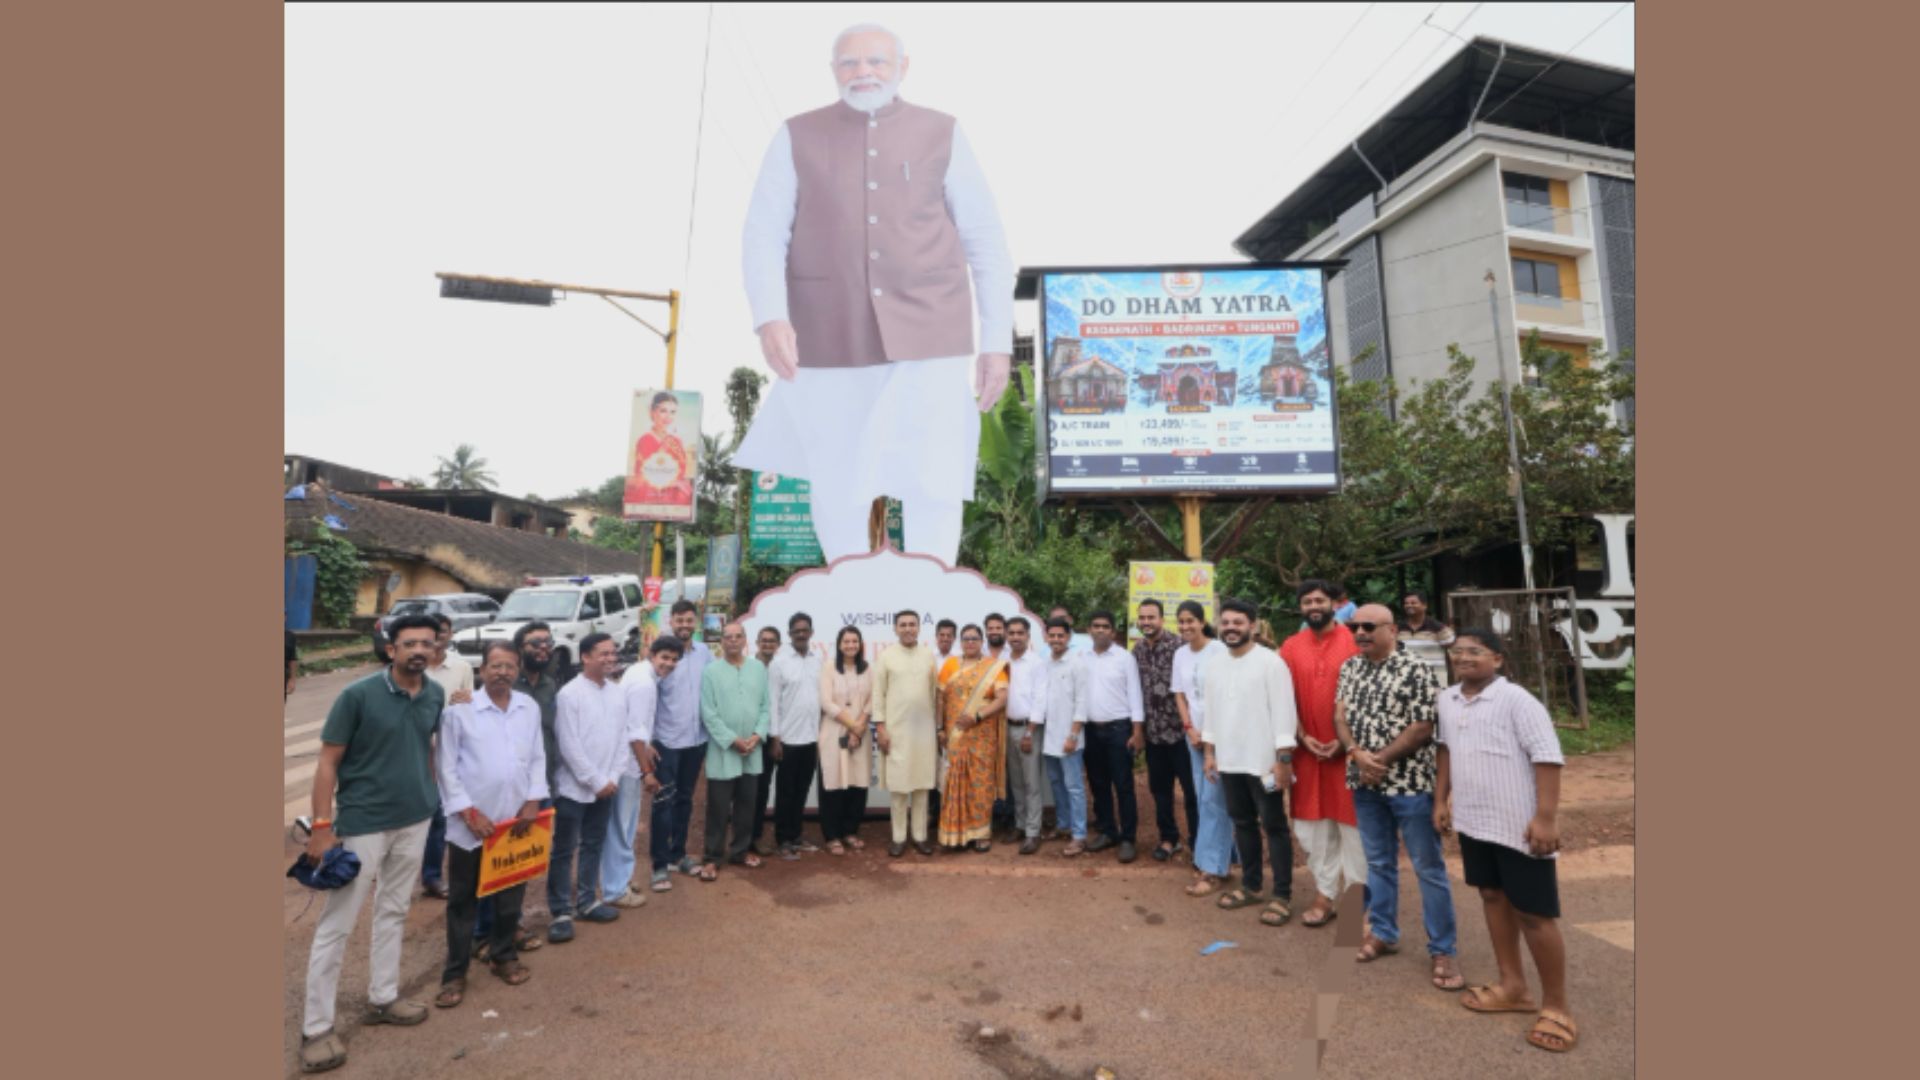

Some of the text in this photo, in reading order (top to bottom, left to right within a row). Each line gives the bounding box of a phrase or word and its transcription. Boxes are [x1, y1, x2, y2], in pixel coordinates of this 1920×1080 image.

[1082, 294, 1293, 316] DO DHAM YATRA
